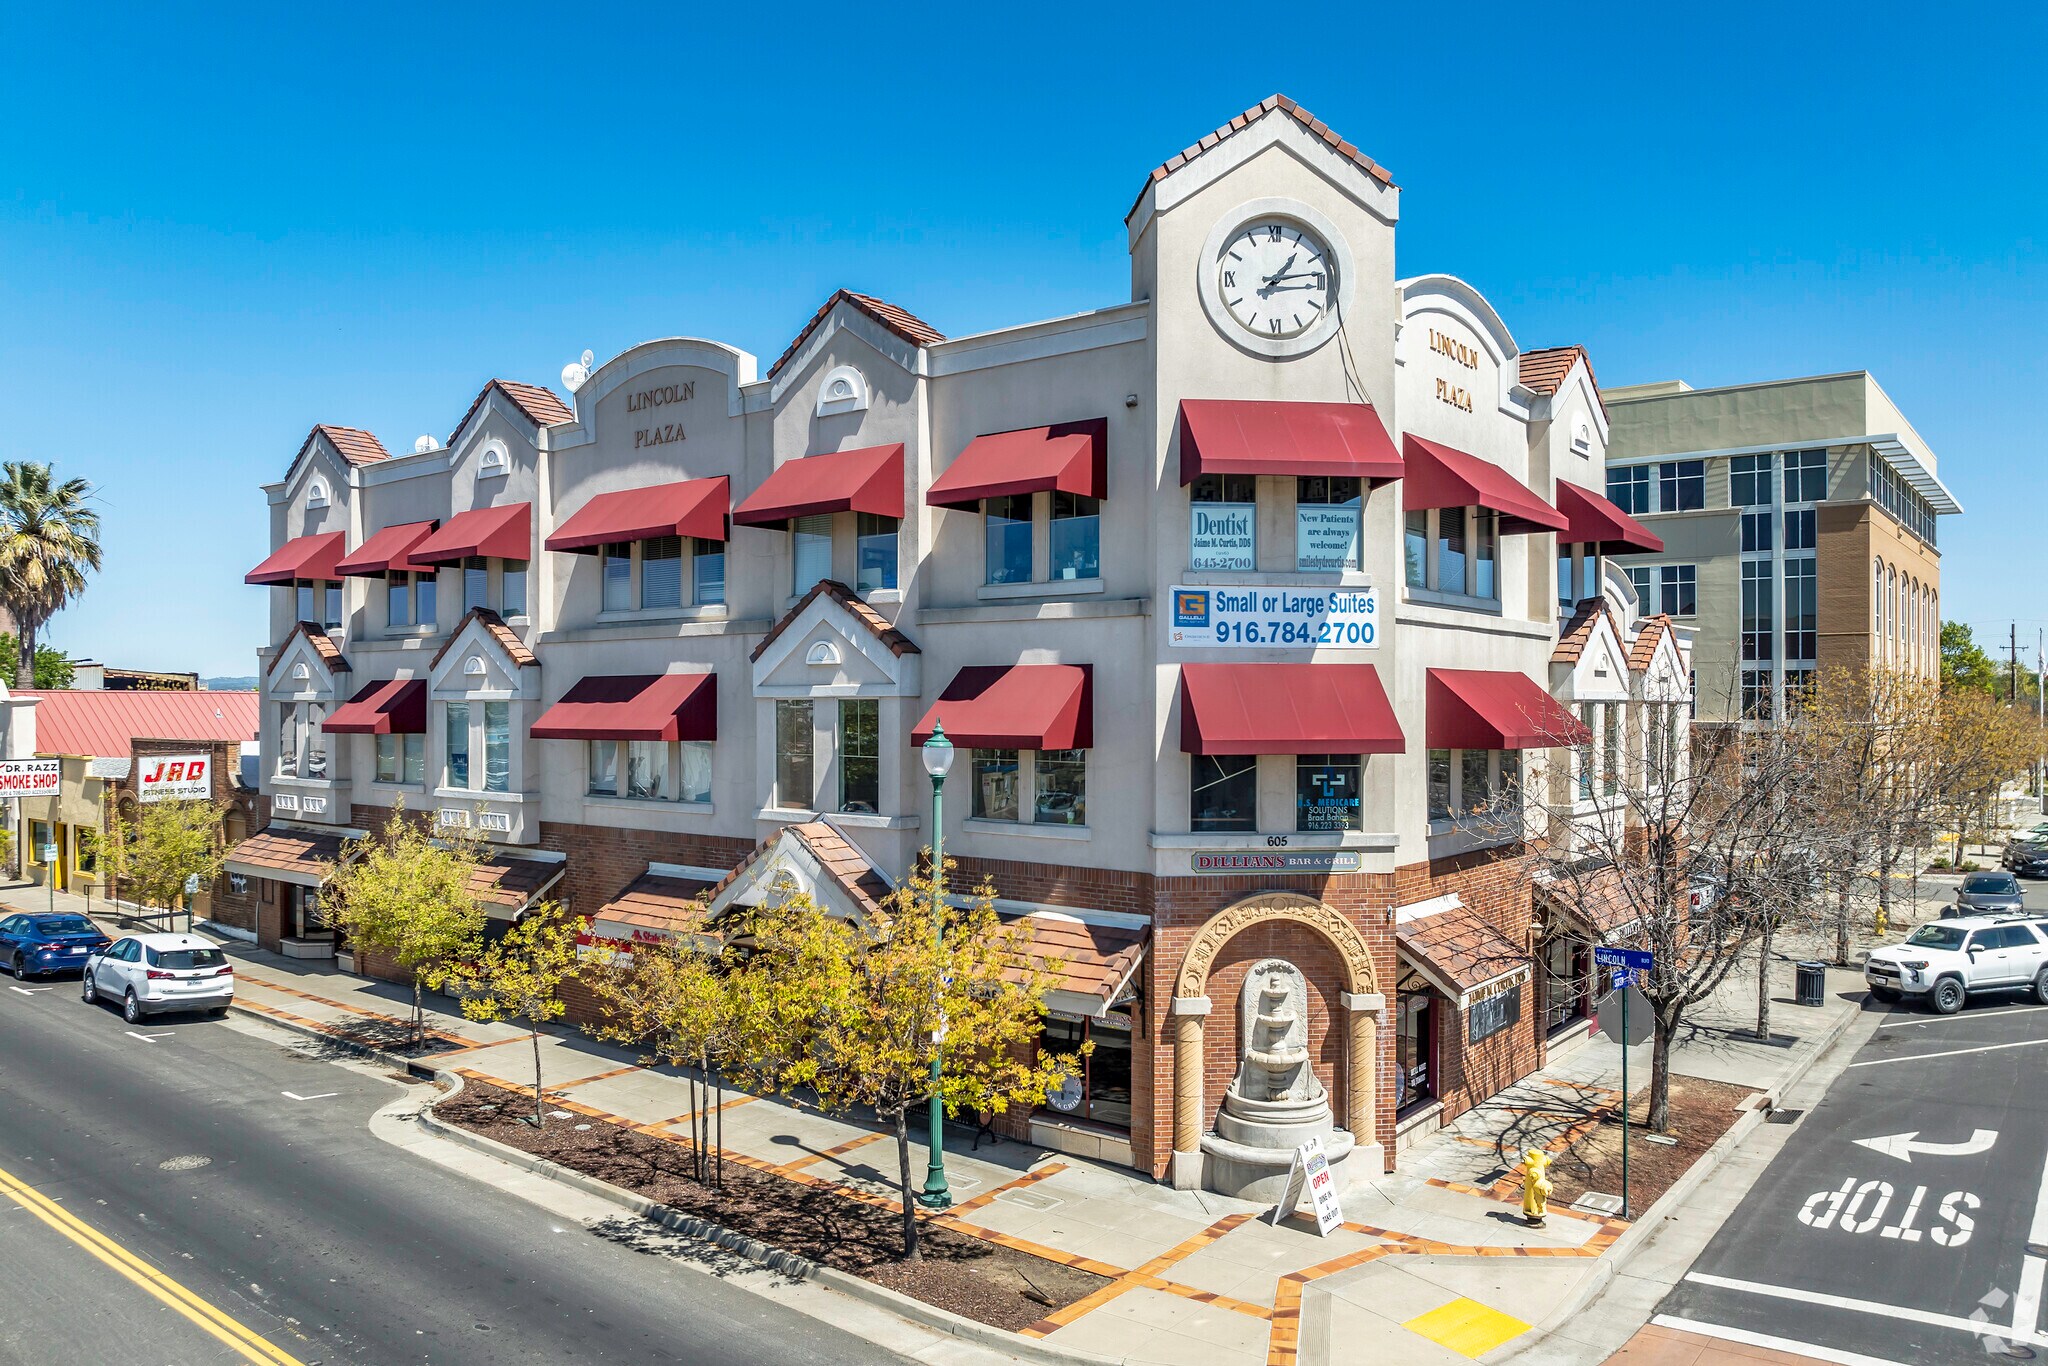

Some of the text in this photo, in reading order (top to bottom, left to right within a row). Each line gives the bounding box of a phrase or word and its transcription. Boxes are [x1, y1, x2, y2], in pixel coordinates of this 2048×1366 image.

[1429, 328, 1478, 370] LINCOLN
[627, 381, 696, 412] LINCOLN
[1436, 377, 1473, 414] PLAZA
[634, 423, 686, 449] PLAZA
[1196, 512, 1248, 535] Dentist
[1299, 514, 1354, 523] New Patients
[1322, 527, 1350, 538] always
[1310, 541, 1348, 549] welcome!
[1193, 558, 1251, 570] 645-2700
[1216, 591, 1375, 617] Small or Large Suites
[1215, 621, 1375, 644] 916.784.2700
[5, 763, 58, 773] DR. RAZZ
[33, 773, 58, 789] SHOP
[178, 786, 207, 795] STUDIO
[1318, 799, 1360, 807] MEDICARE
[1308, 806, 1348, 814] SOLUTIONS
[1307, 813, 1325, 821] Brad
[1267, 836, 1288, 847] 605
[1198, 855, 1286, 869] DILLIANS
[1324, 857, 1357, 866] GRILL
[1597, 953, 1626, 965] LINCOLN
[1312, 1171, 1330, 1190] OPEN
[1797, 1177, 1981, 1247] STOP
